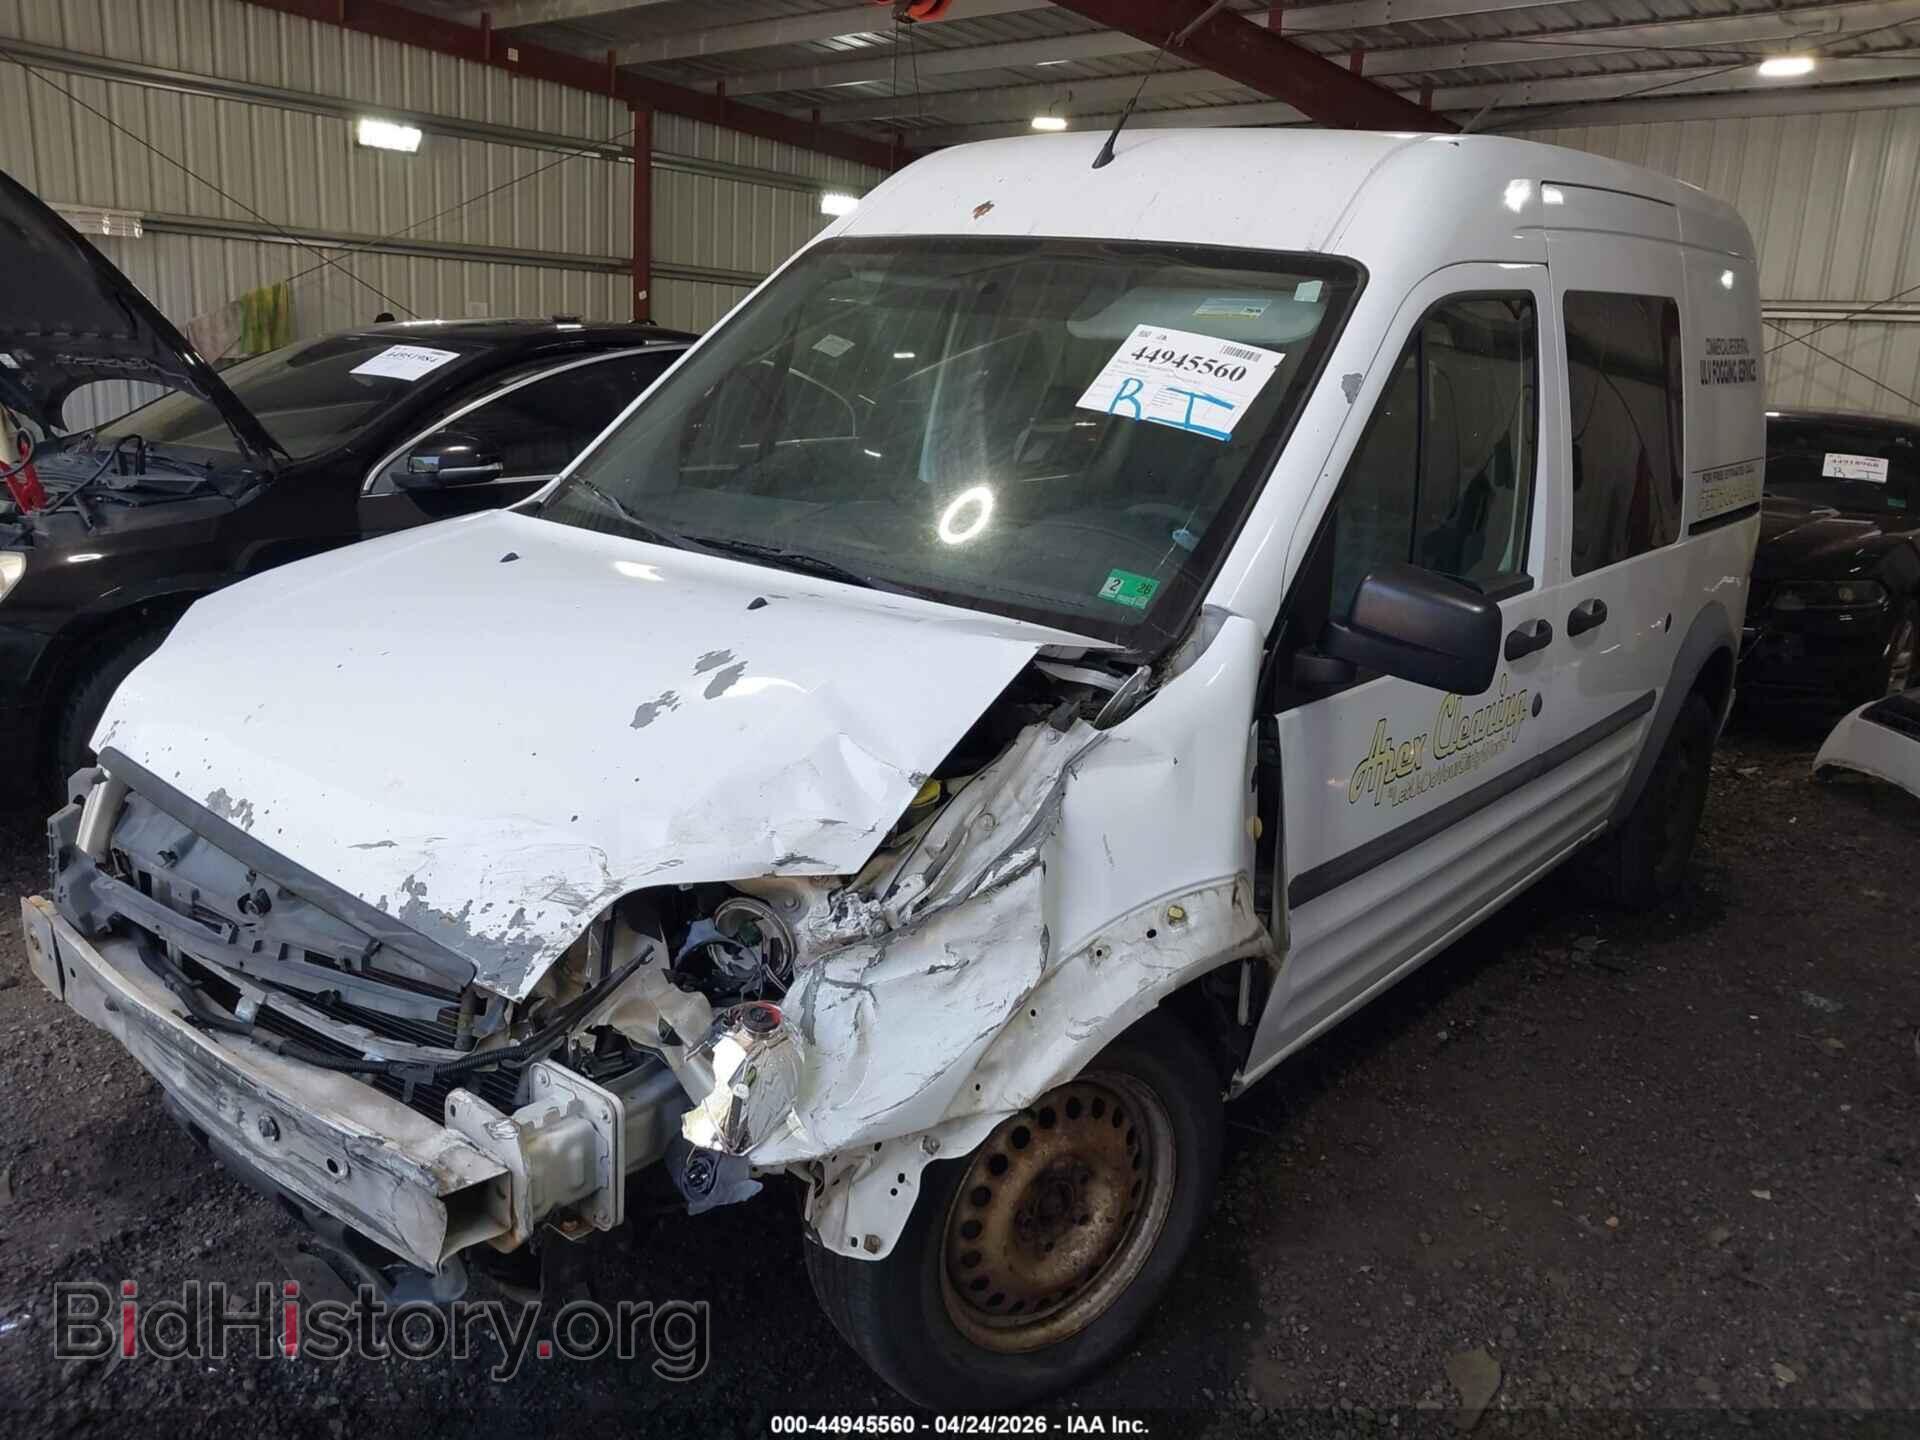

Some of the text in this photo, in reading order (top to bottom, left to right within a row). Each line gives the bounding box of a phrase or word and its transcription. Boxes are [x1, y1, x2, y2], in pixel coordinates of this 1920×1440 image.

[1131, 345, 1247, 382] 44945560
[1108, 376, 1144, 421] R
[1109, 580, 1121, 591] 2
[1348, 717, 1427, 807] Apex
[1432, 672, 1528, 762] Cleaning
